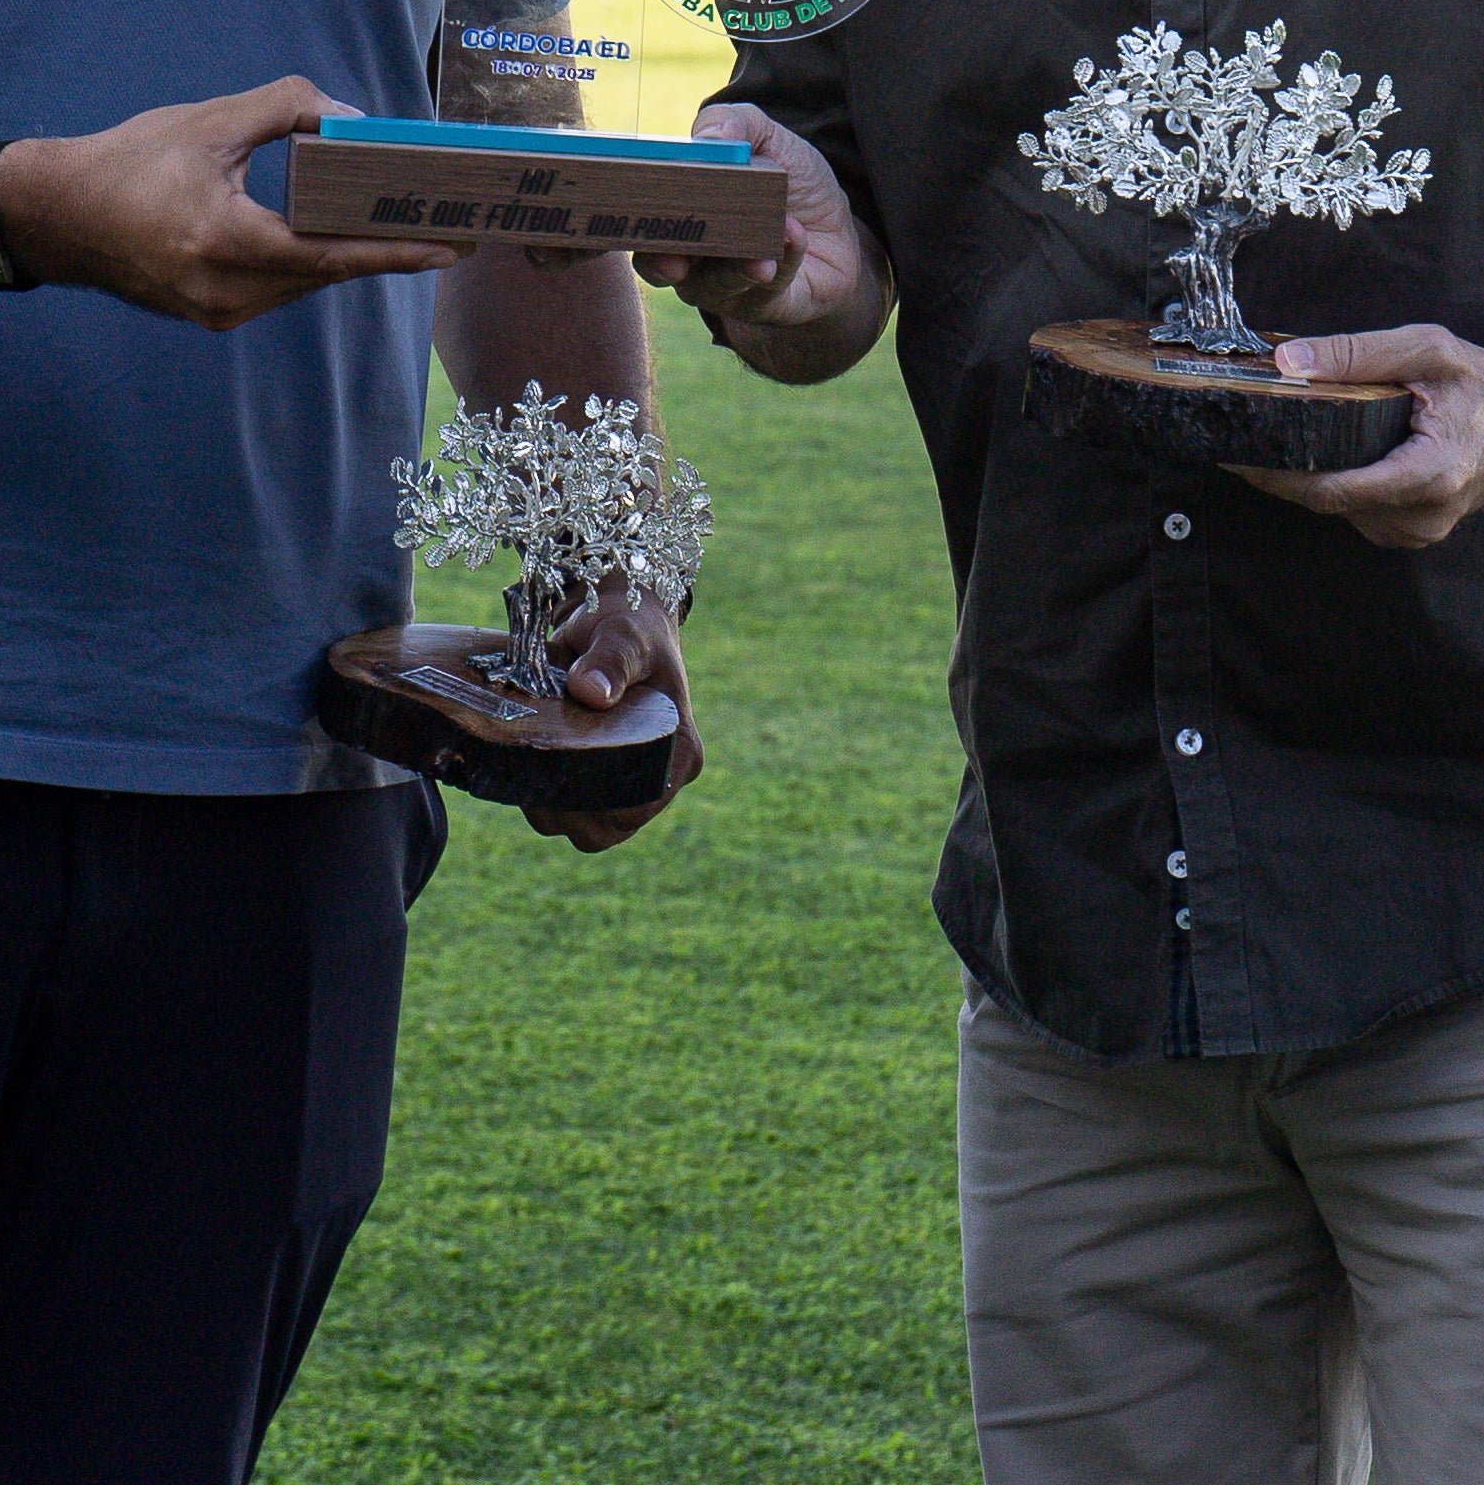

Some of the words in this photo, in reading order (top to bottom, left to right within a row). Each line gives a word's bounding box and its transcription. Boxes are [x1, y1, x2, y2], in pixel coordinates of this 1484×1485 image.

[723, 9, 792, 32] CLUB
[462, 25, 593, 58] CÓRDOBA
[429, 200, 482, 229] QUE
